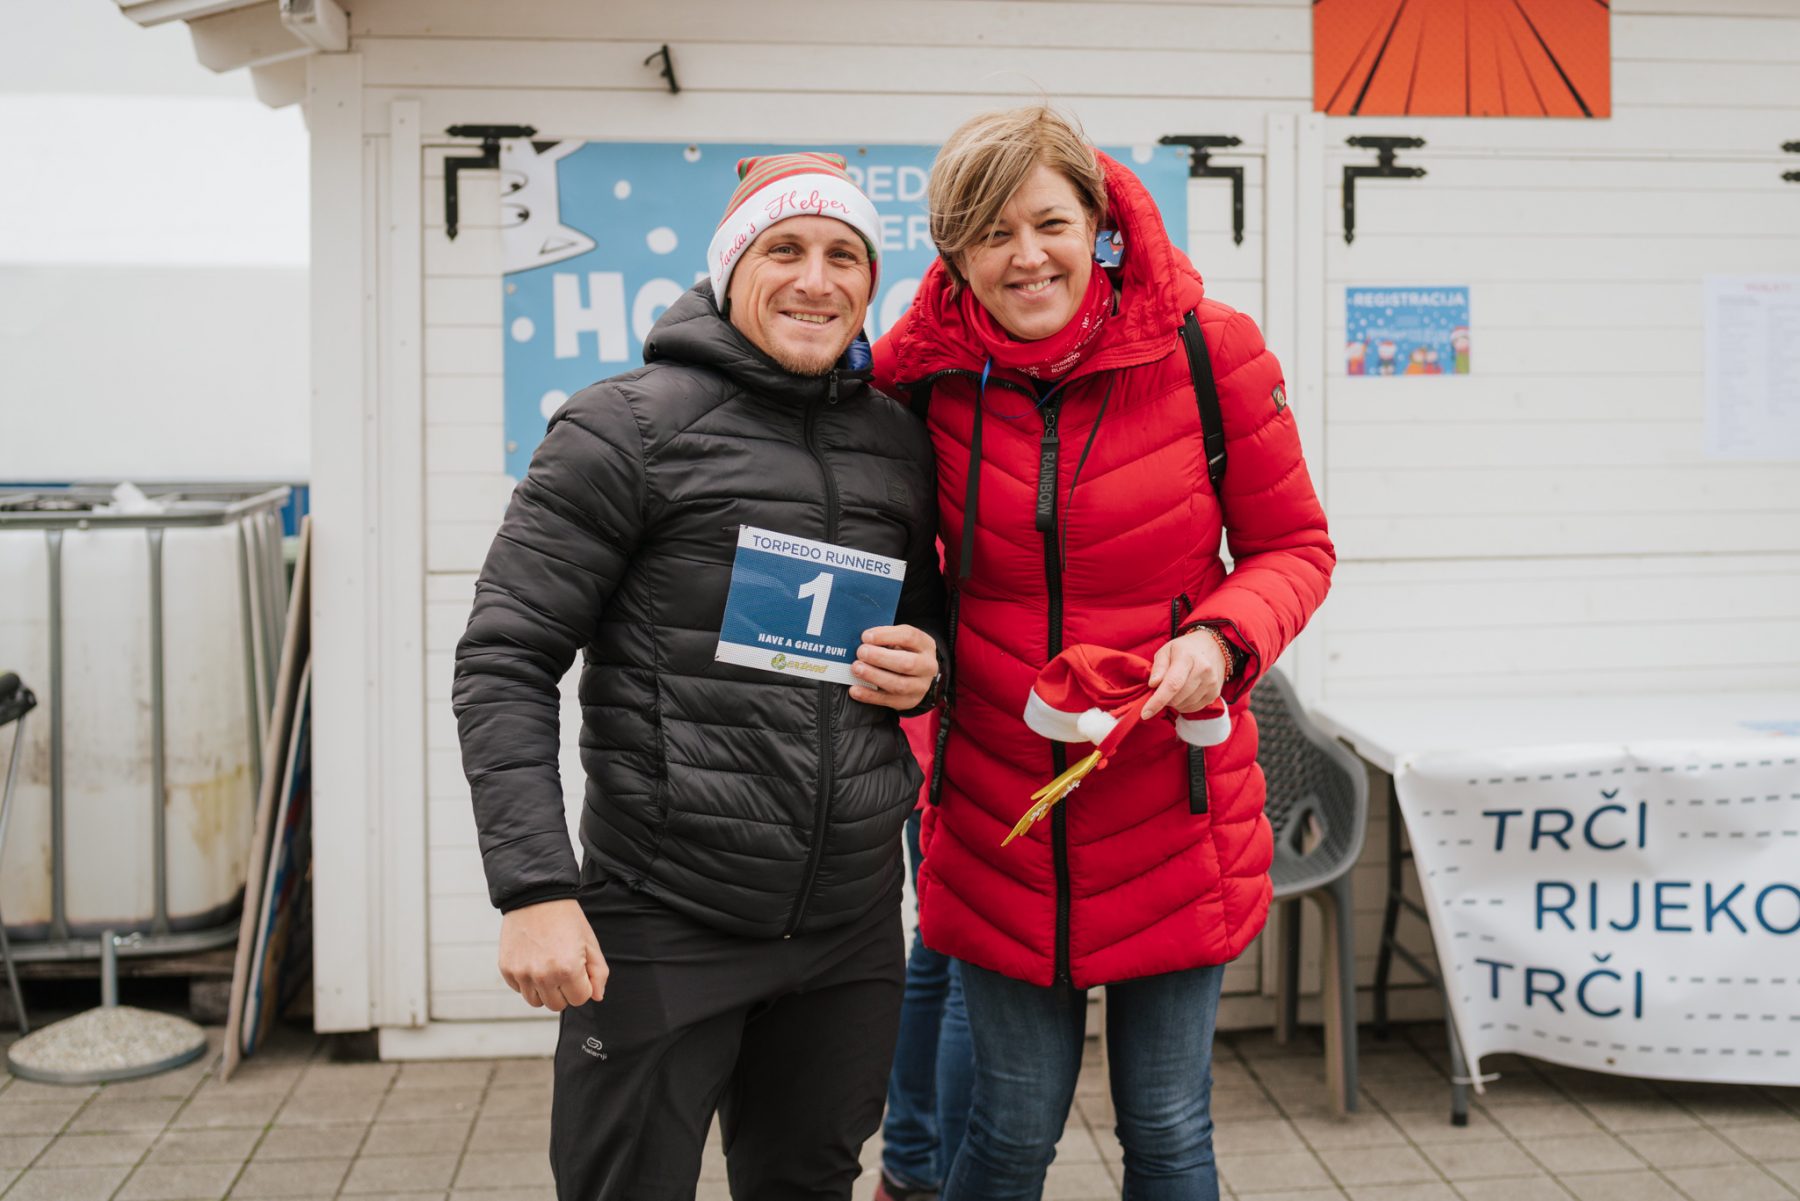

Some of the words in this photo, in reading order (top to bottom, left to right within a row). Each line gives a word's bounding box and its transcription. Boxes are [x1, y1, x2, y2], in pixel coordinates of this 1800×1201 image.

[717, 222, 757, 283] Santa's
[764, 190, 850, 220] Helper
[1353, 291, 1465, 308] REGISTRACIJA
[1037, 451, 1056, 515] RAINBOW
[753, 534, 821, 560] TORPEDO
[825, 551, 892, 575] RUNNERS
[797, 571, 834, 637] 1
[758, 632, 784, 646] HAVE
[785, 638, 793, 648] A
[794, 640, 825, 653] GREAT
[824, 645, 848, 657] RUN!
[1191, 745, 1205, 798] AINBOW
[1482, 787, 1647, 852] TRČI
[1474, 951, 1643, 1019] TRČI
